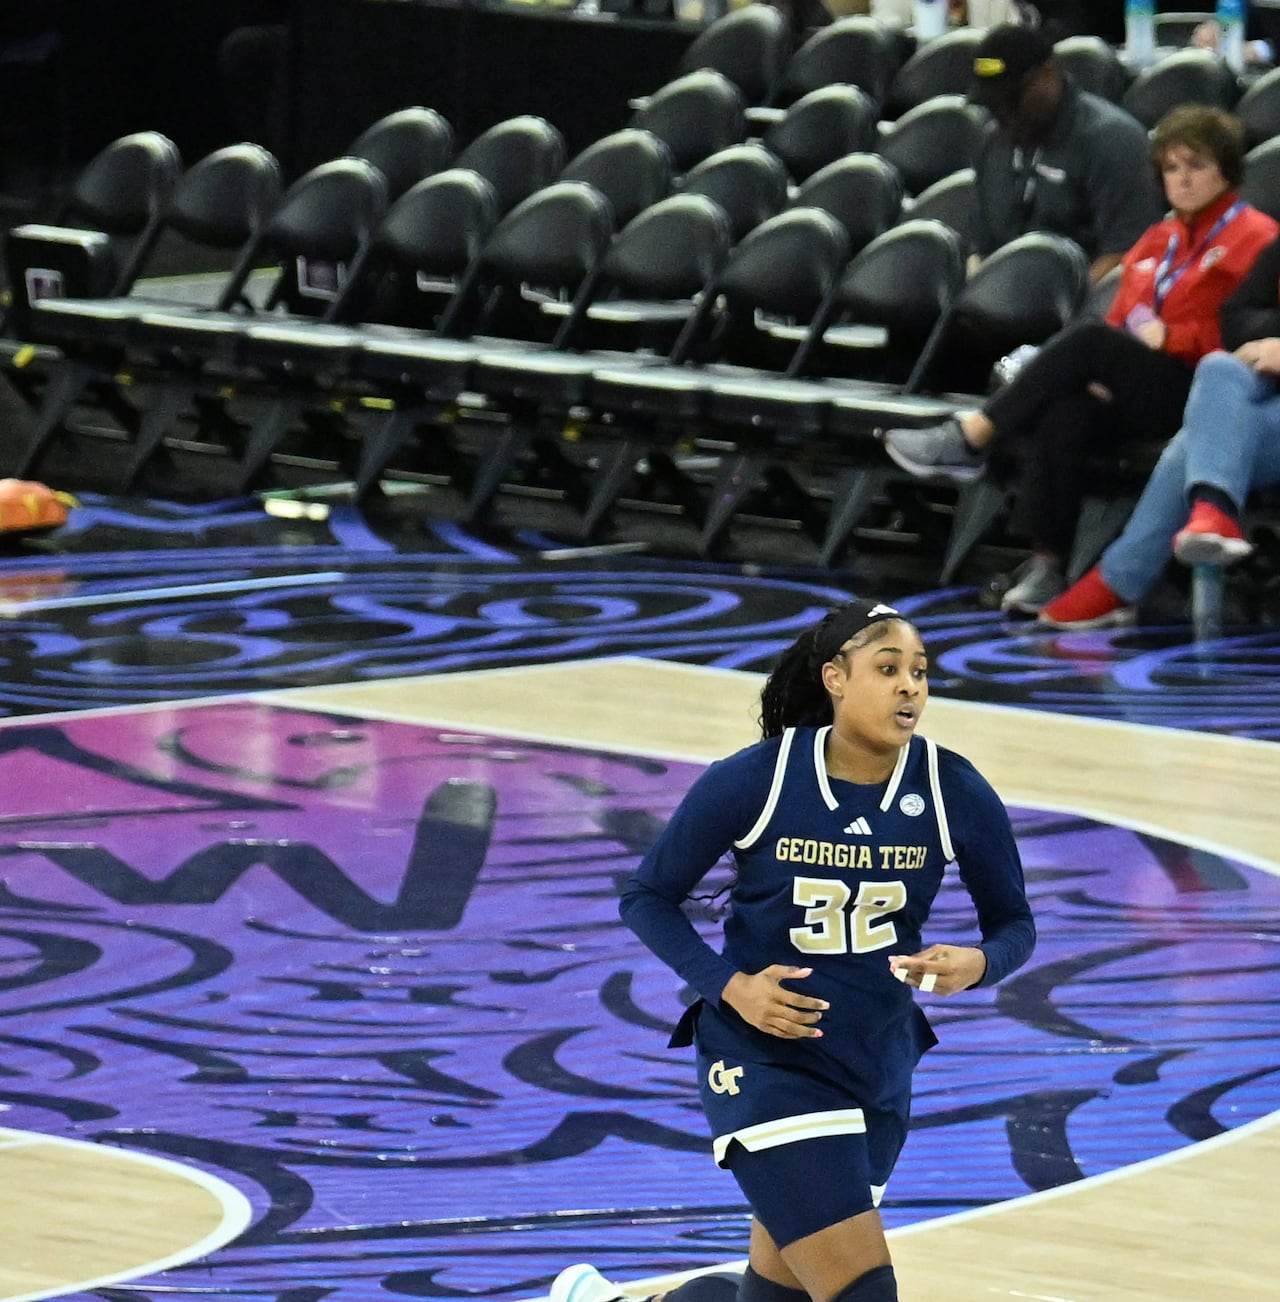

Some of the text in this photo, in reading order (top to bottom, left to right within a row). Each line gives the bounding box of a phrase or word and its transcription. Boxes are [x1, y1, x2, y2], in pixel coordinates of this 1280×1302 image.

[775, 837, 928, 870] GEORGIA TECH
[789, 876, 907, 954] 32
